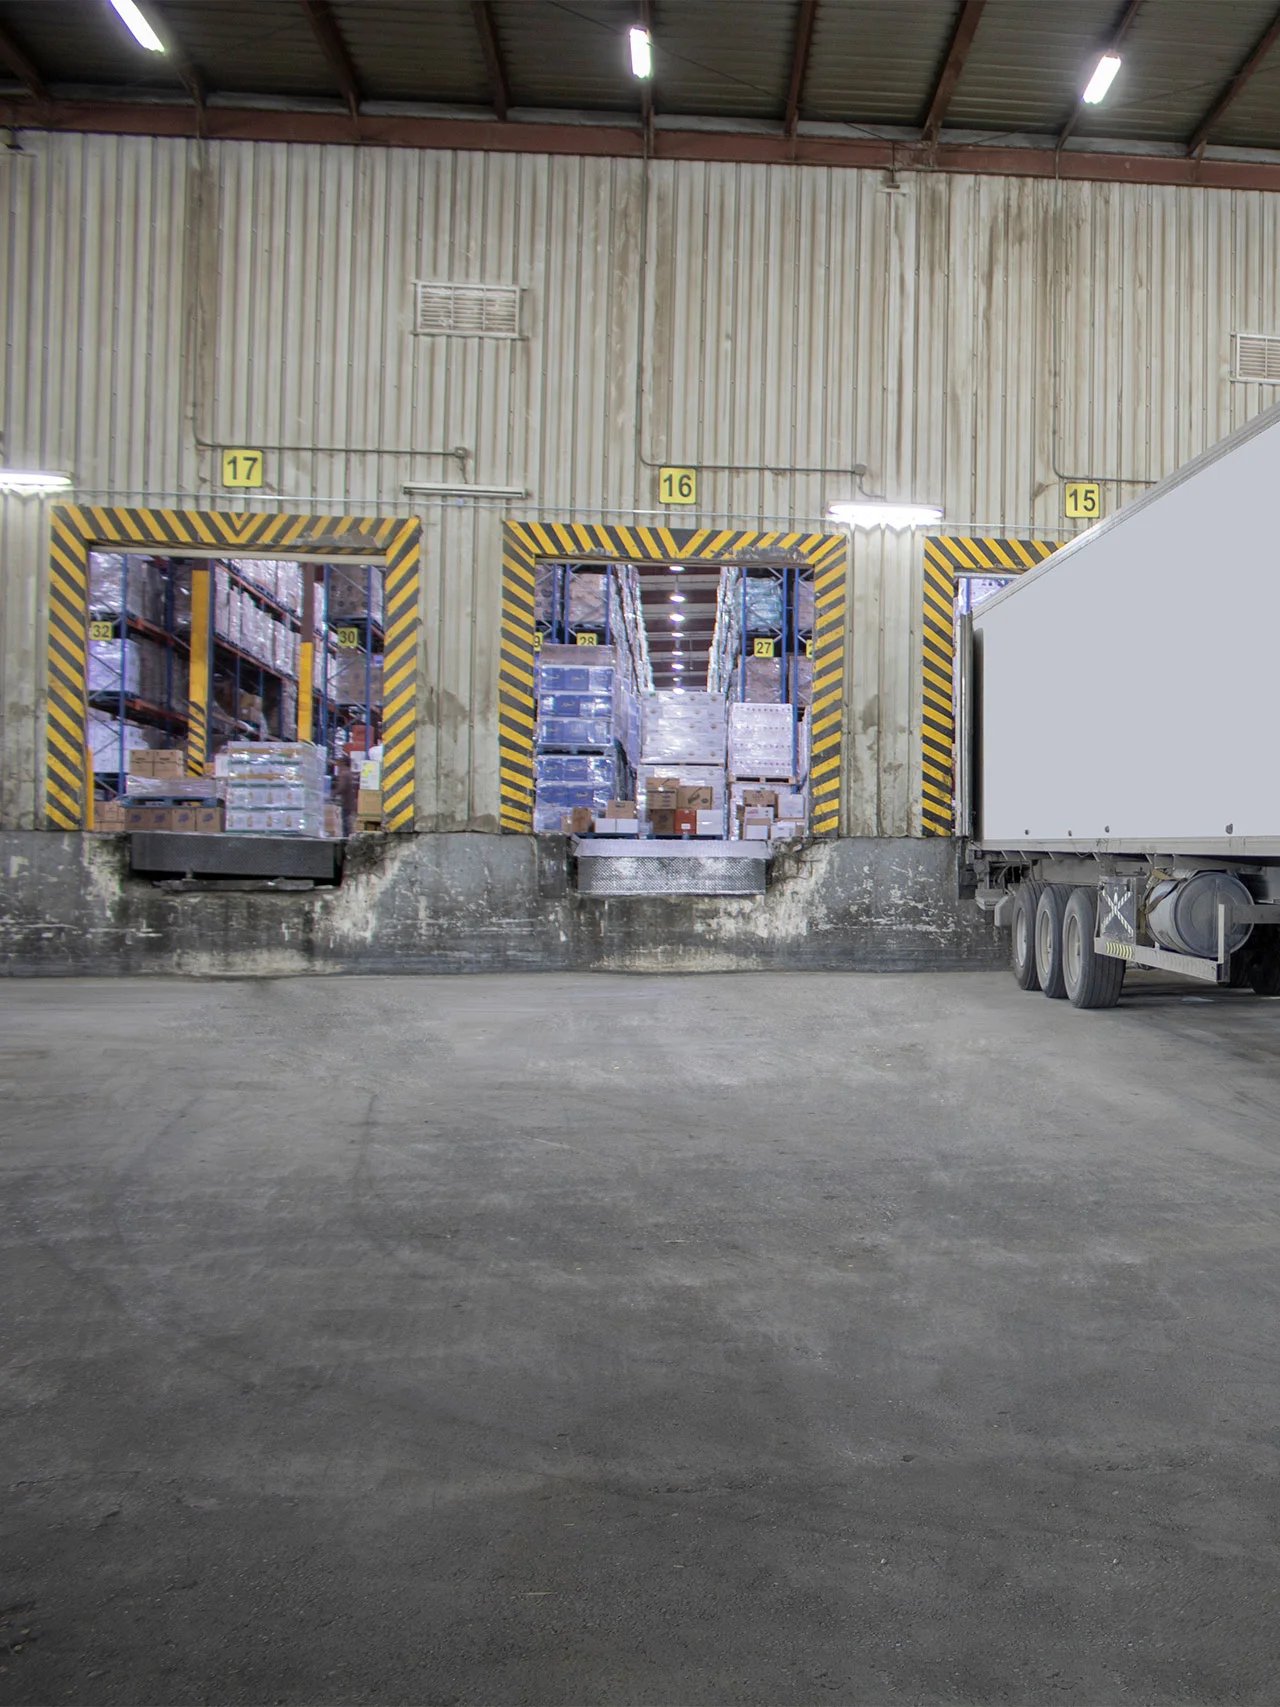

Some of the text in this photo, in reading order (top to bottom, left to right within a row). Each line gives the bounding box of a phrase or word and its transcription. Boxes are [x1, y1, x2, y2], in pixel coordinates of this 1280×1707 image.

[226, 455, 258, 481] 17
[662, 472, 693, 498] 16
[1068, 487, 1096, 512] 15
[92, 624, 110, 639] 32
[339, 630, 356, 644] 30
[755, 641, 772, 654] 27
